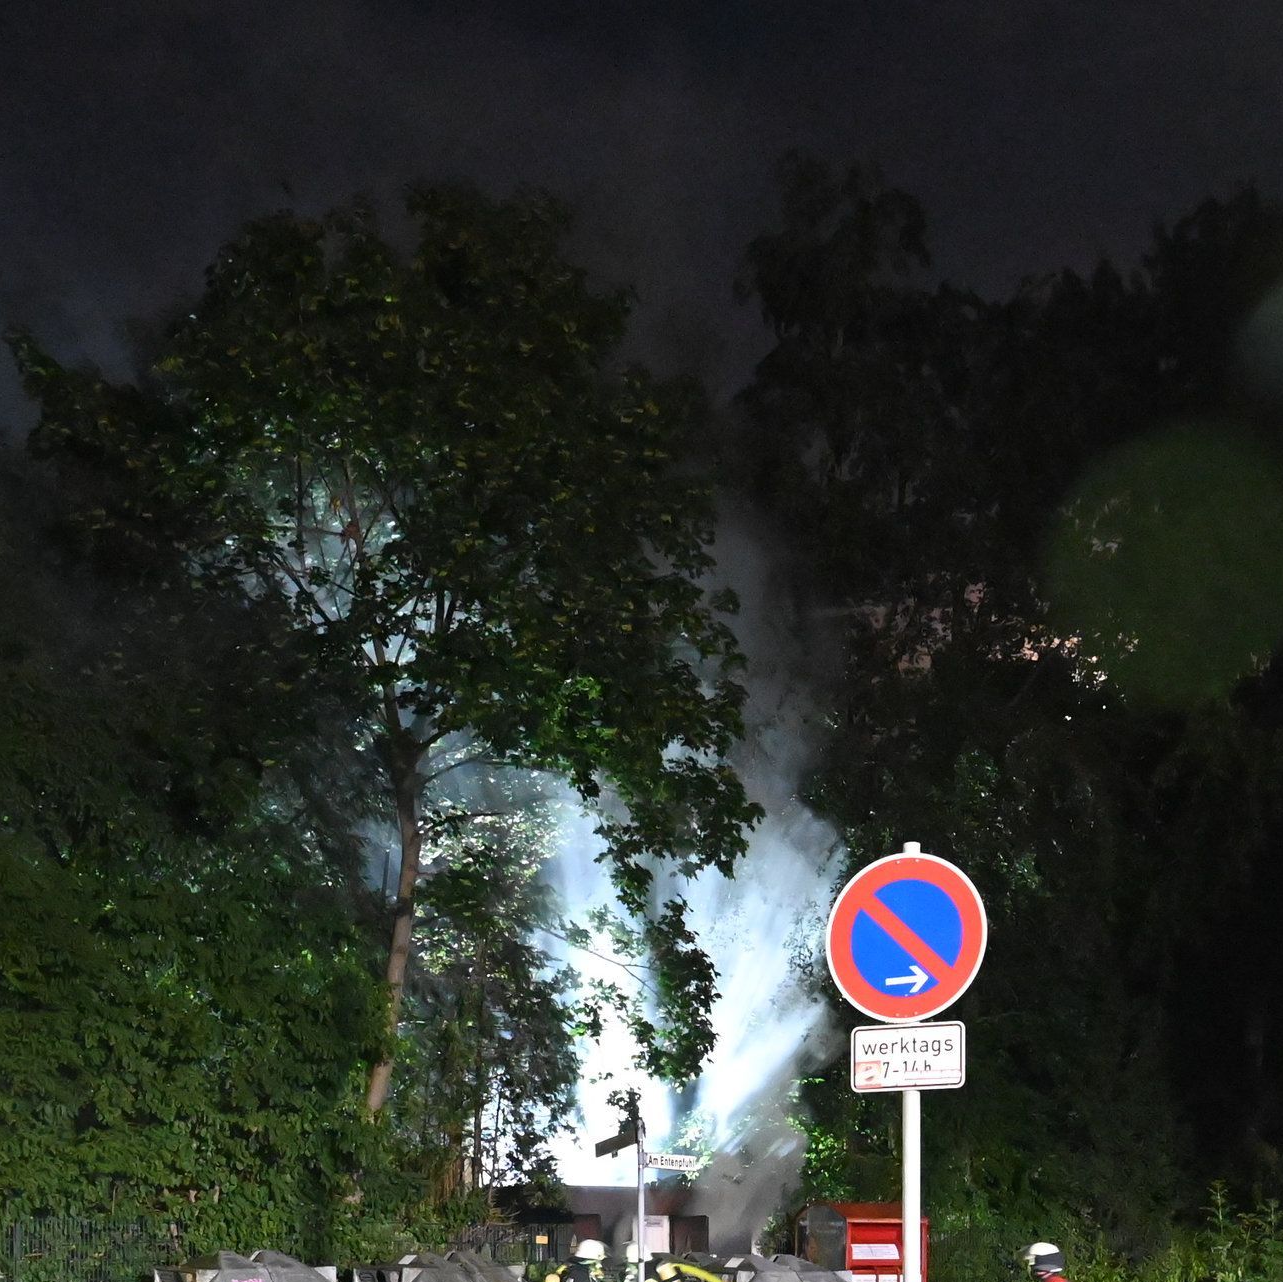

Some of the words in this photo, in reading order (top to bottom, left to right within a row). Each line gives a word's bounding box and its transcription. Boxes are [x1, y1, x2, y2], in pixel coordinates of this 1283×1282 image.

[862, 1037, 954, 1057] werktags
[648, 1155, 659, 1165] Am
[660, 1156, 695, 1168] Entenpfuhl
